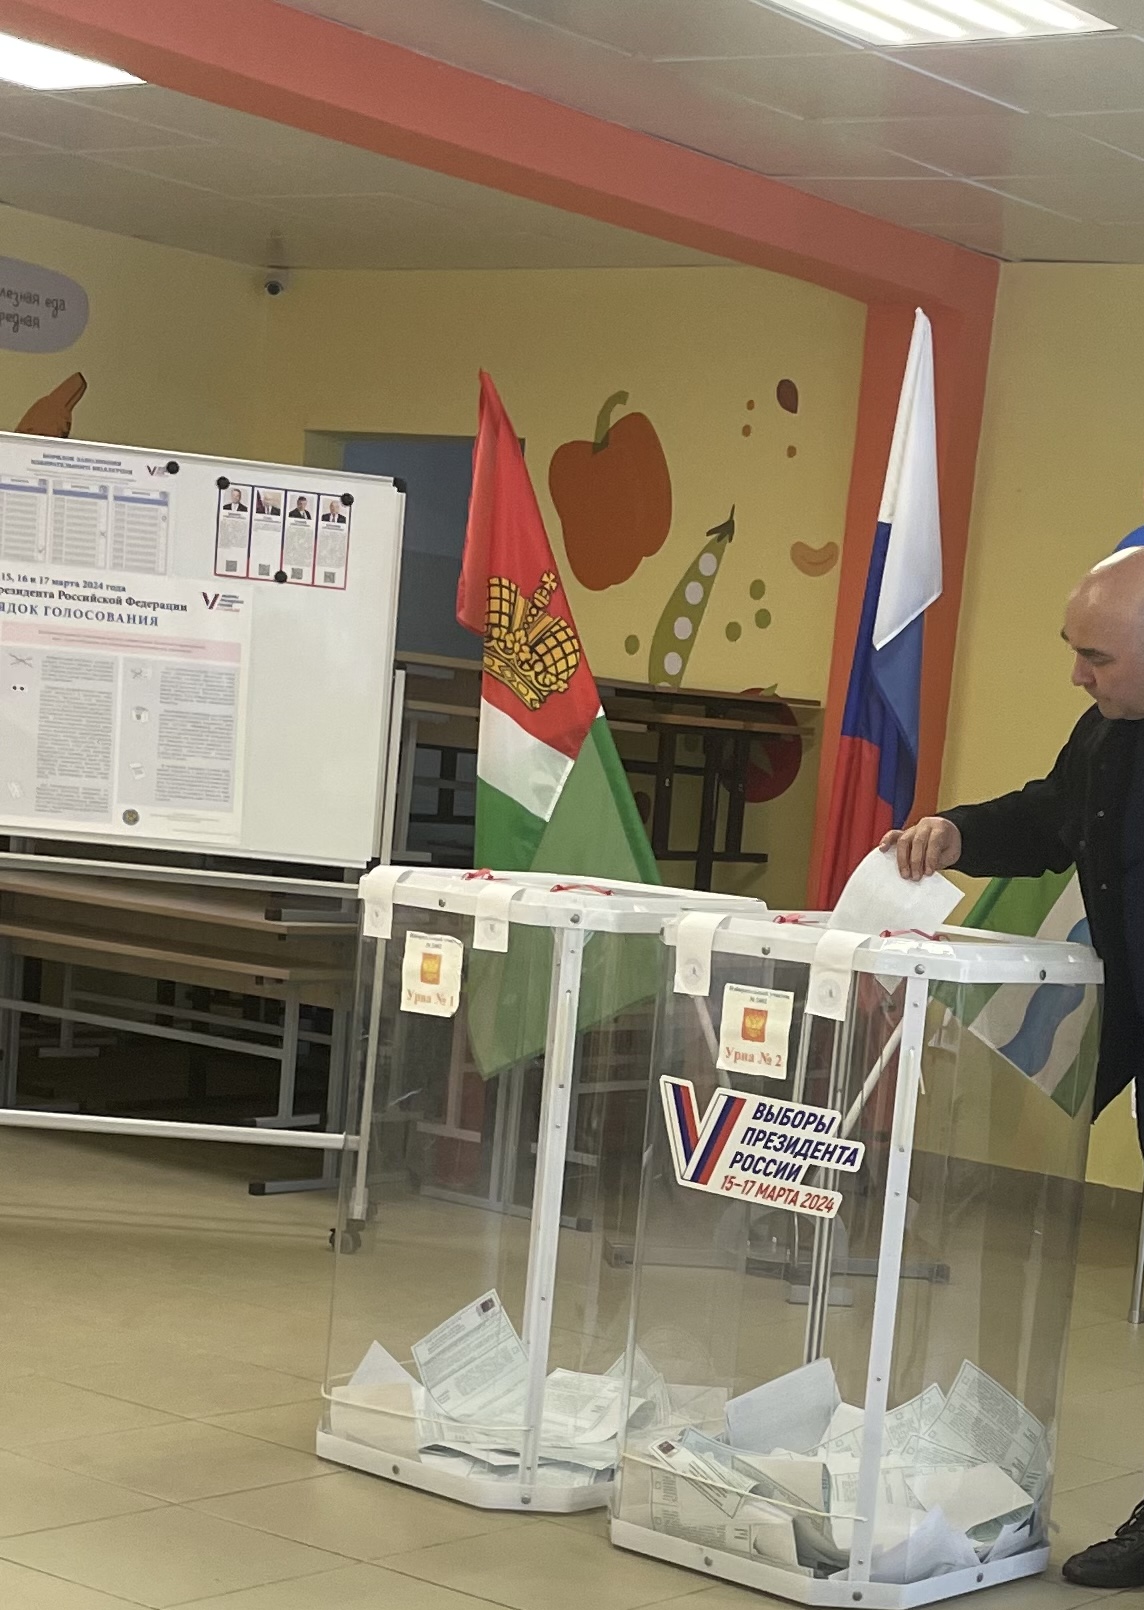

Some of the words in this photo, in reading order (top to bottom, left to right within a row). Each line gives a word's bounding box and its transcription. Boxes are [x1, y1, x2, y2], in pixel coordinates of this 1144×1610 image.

[45, 298, 66, 319] еда
[58, 590, 123, 606] Российской
[125, 597, 188, 612] Федерации
[44, 605, 159, 627] ГОЛОСОВАНИЯ
[407, 988, 432, 1005] Урна
[725, 1046, 755, 1064] Урна
[758, 1051, 773, 1066] №
[774, 1054, 783, 1068] 2
[752, 1101, 837, 1135] ВЫБОРЫ
[740, 1126, 860, 1168] ПРЕЗИДЕНТА
[728, 1150, 803, 1183] РОССИИ
[755, 1184, 800, 1207] МАРТА
[799, 1192, 835, 1213] 2024
